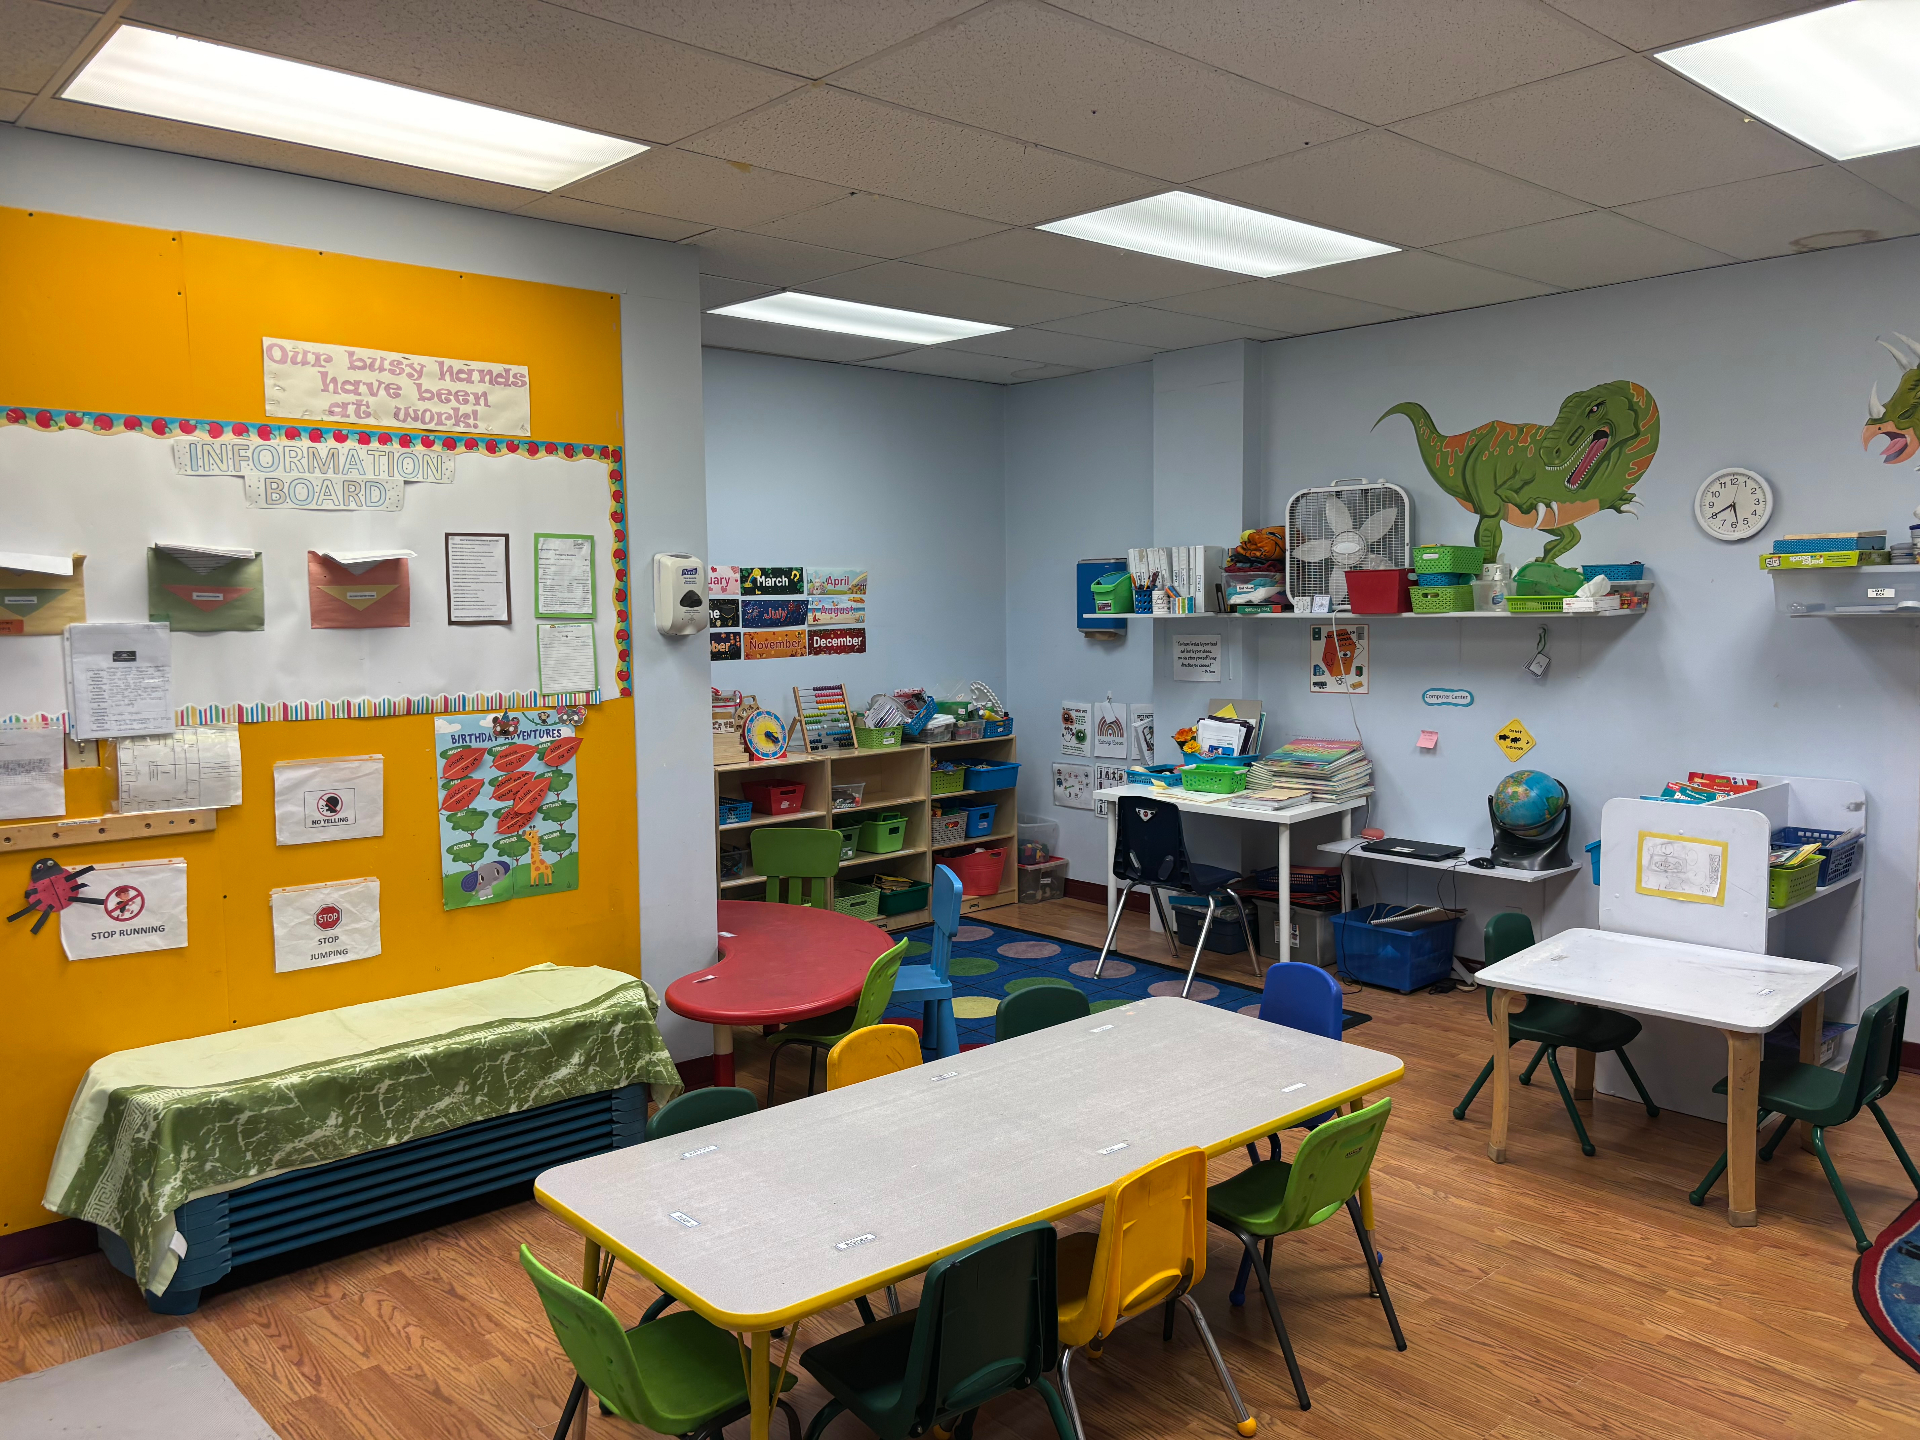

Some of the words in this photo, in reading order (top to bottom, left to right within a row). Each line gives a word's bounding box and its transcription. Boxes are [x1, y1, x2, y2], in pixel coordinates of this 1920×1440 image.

[266, 343, 334, 368] Our
[344, 350, 426, 381] busy
[435, 360, 528, 388] hands
[318, 371, 402, 398] have
[414, 382, 491, 408] been
[328, 399, 371, 420] at
[394, 405, 478, 429] work!
[190, 442, 442, 480] INFORMATION
[264, 478, 386, 508] BOARD
[757, 575, 788, 587] March
[826, 576, 849, 589] April
[764, 608, 788, 621] July
[820, 605, 854, 617] August
[710, 641, 730, 652] ber
[750, 639, 802, 650] November
[813, 636, 863, 648] December
[318, 913, 338, 923] STOP
[91, 930, 117, 940] STOP
[119, 925, 166, 937] RUNNING
[318, 936, 339, 946] STOP
[310, 948, 349, 960] JUMPING
